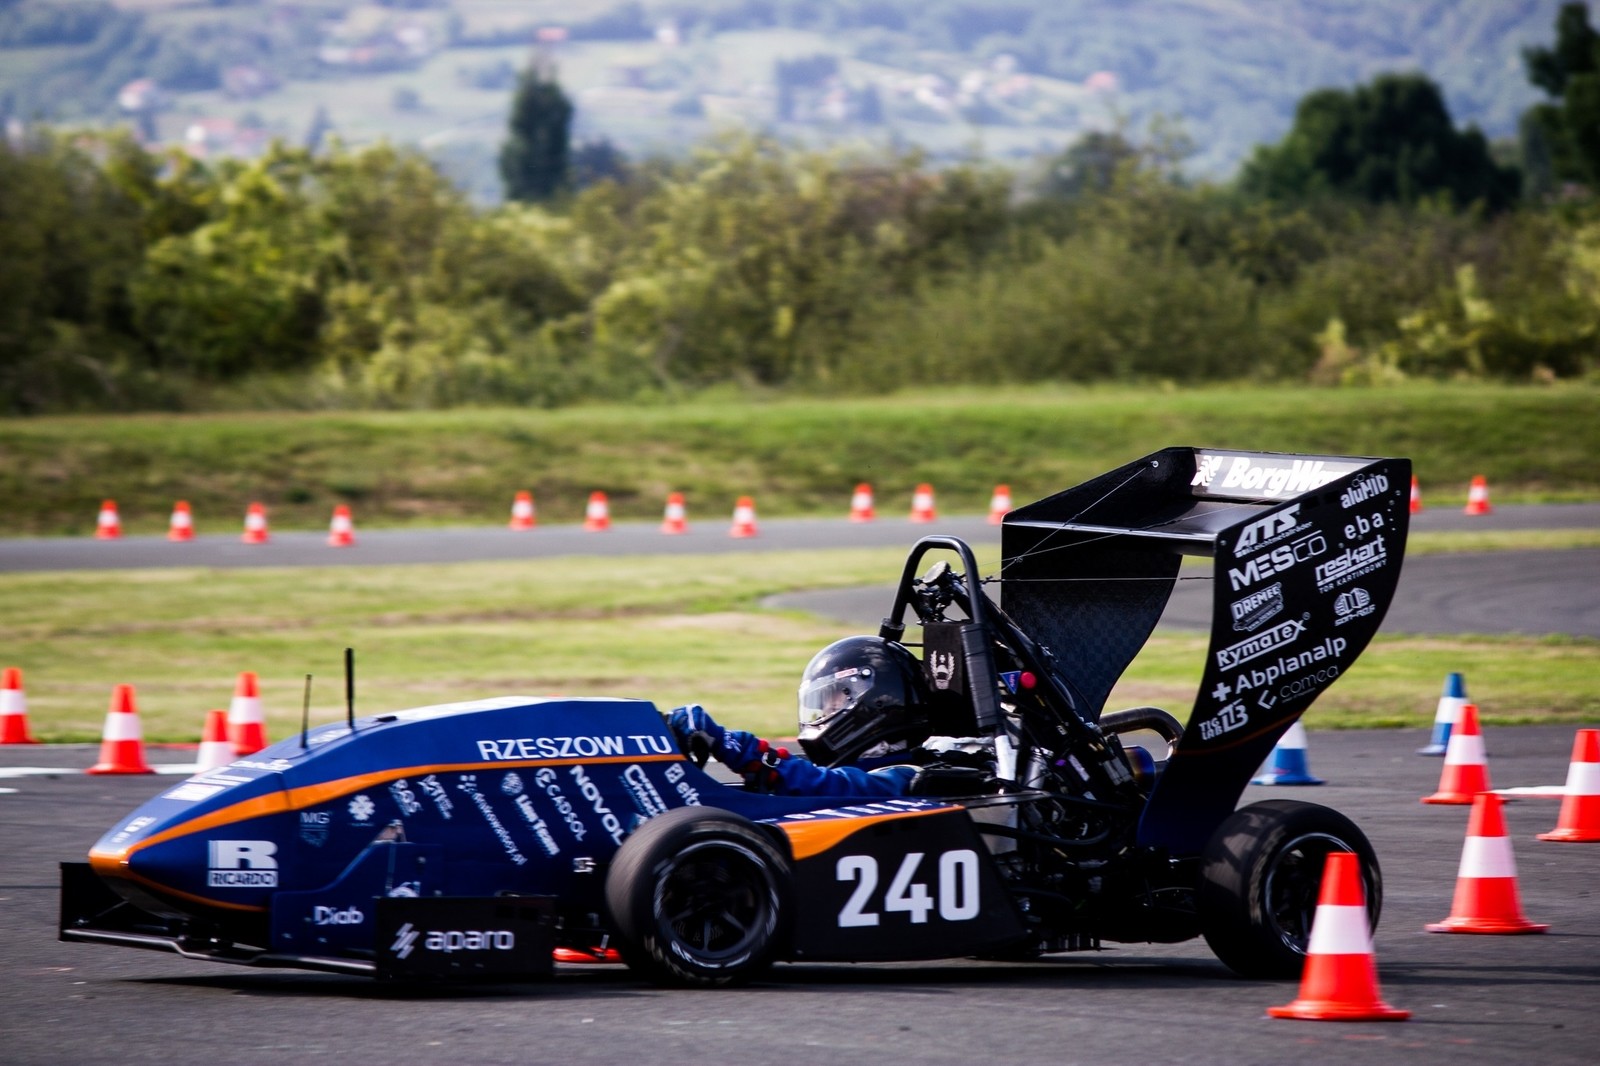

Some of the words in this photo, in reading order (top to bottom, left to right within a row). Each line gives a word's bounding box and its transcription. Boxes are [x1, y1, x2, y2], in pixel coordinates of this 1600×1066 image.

[1233, 503, 1300, 553] ATS
[1344, 512, 1384, 539] eba
[1315, 534, 1387, 581] reskart
[1235, 637, 1347, 694] Abplanalp
[476, 736, 624, 761] RZESZOW
[627, 735, 673, 754] TU
[569, 764, 624, 846] NOVOL
[212, 872, 277, 885] RICARDO
[836, 849, 980, 928] 240
[425, 930, 515, 953] aparo
